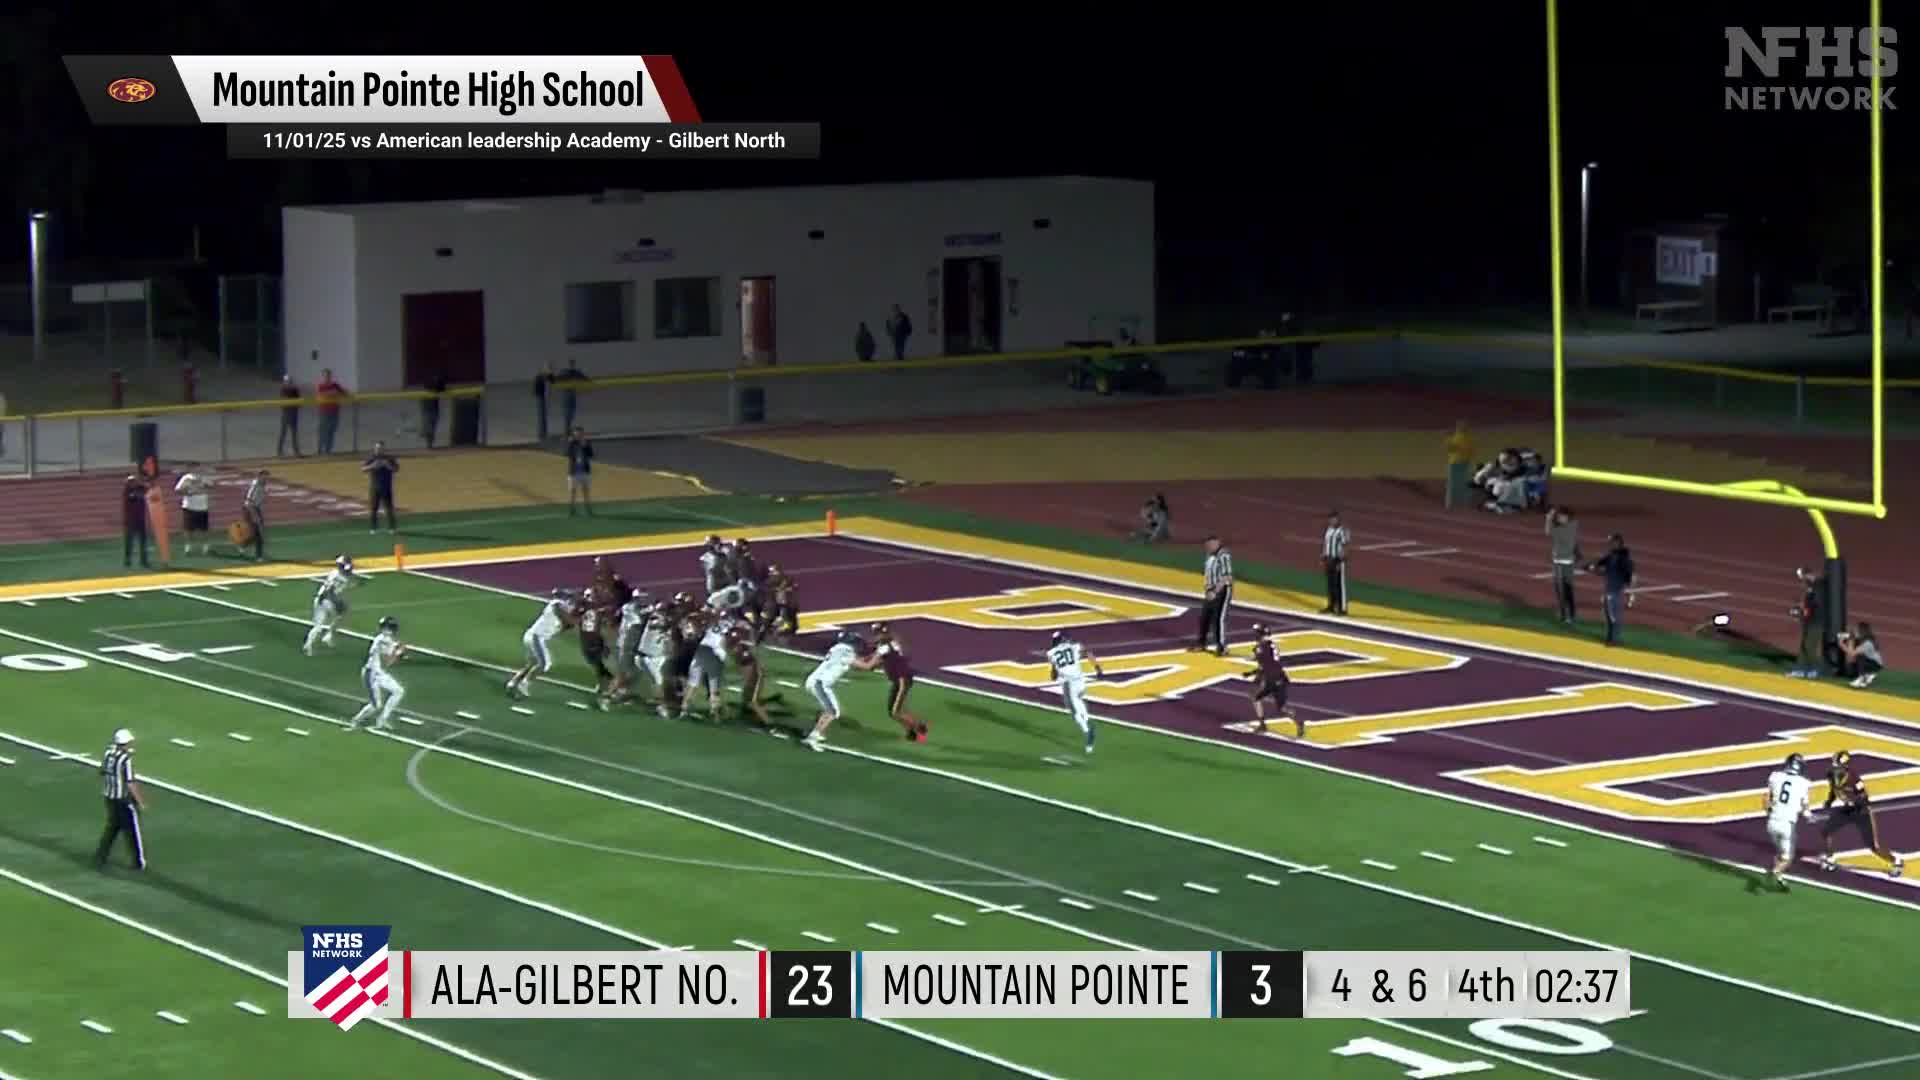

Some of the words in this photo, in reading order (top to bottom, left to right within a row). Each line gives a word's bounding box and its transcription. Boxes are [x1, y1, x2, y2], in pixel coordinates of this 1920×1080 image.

[1054, 647, 1076, 668] 20
[1778, 782, 1793, 805] 6
[1330, 1017, 1614, 1079] 10
